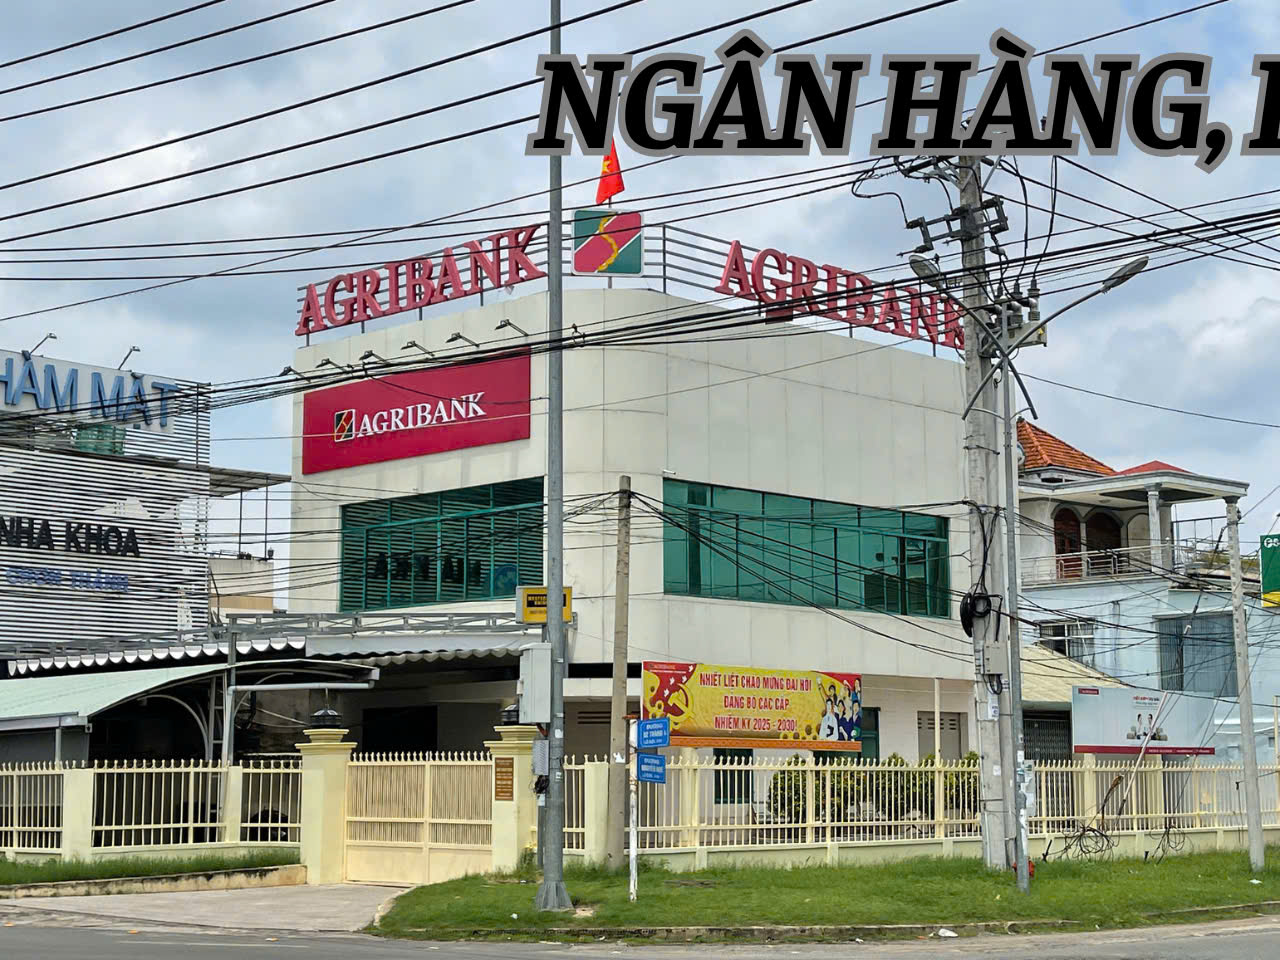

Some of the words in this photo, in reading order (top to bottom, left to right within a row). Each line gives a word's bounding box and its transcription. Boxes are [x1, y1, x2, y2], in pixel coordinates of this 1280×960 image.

[295, 224, 548, 337] AGRIBANK
[714, 239, 966, 350] AGRIBANK
[356, 391, 488, 439] AGRIBANK
[65, 520, 141, 558] KHOA
[754, 719, 770, 730] 2025
[778, 719, 797, 731] 2030!
